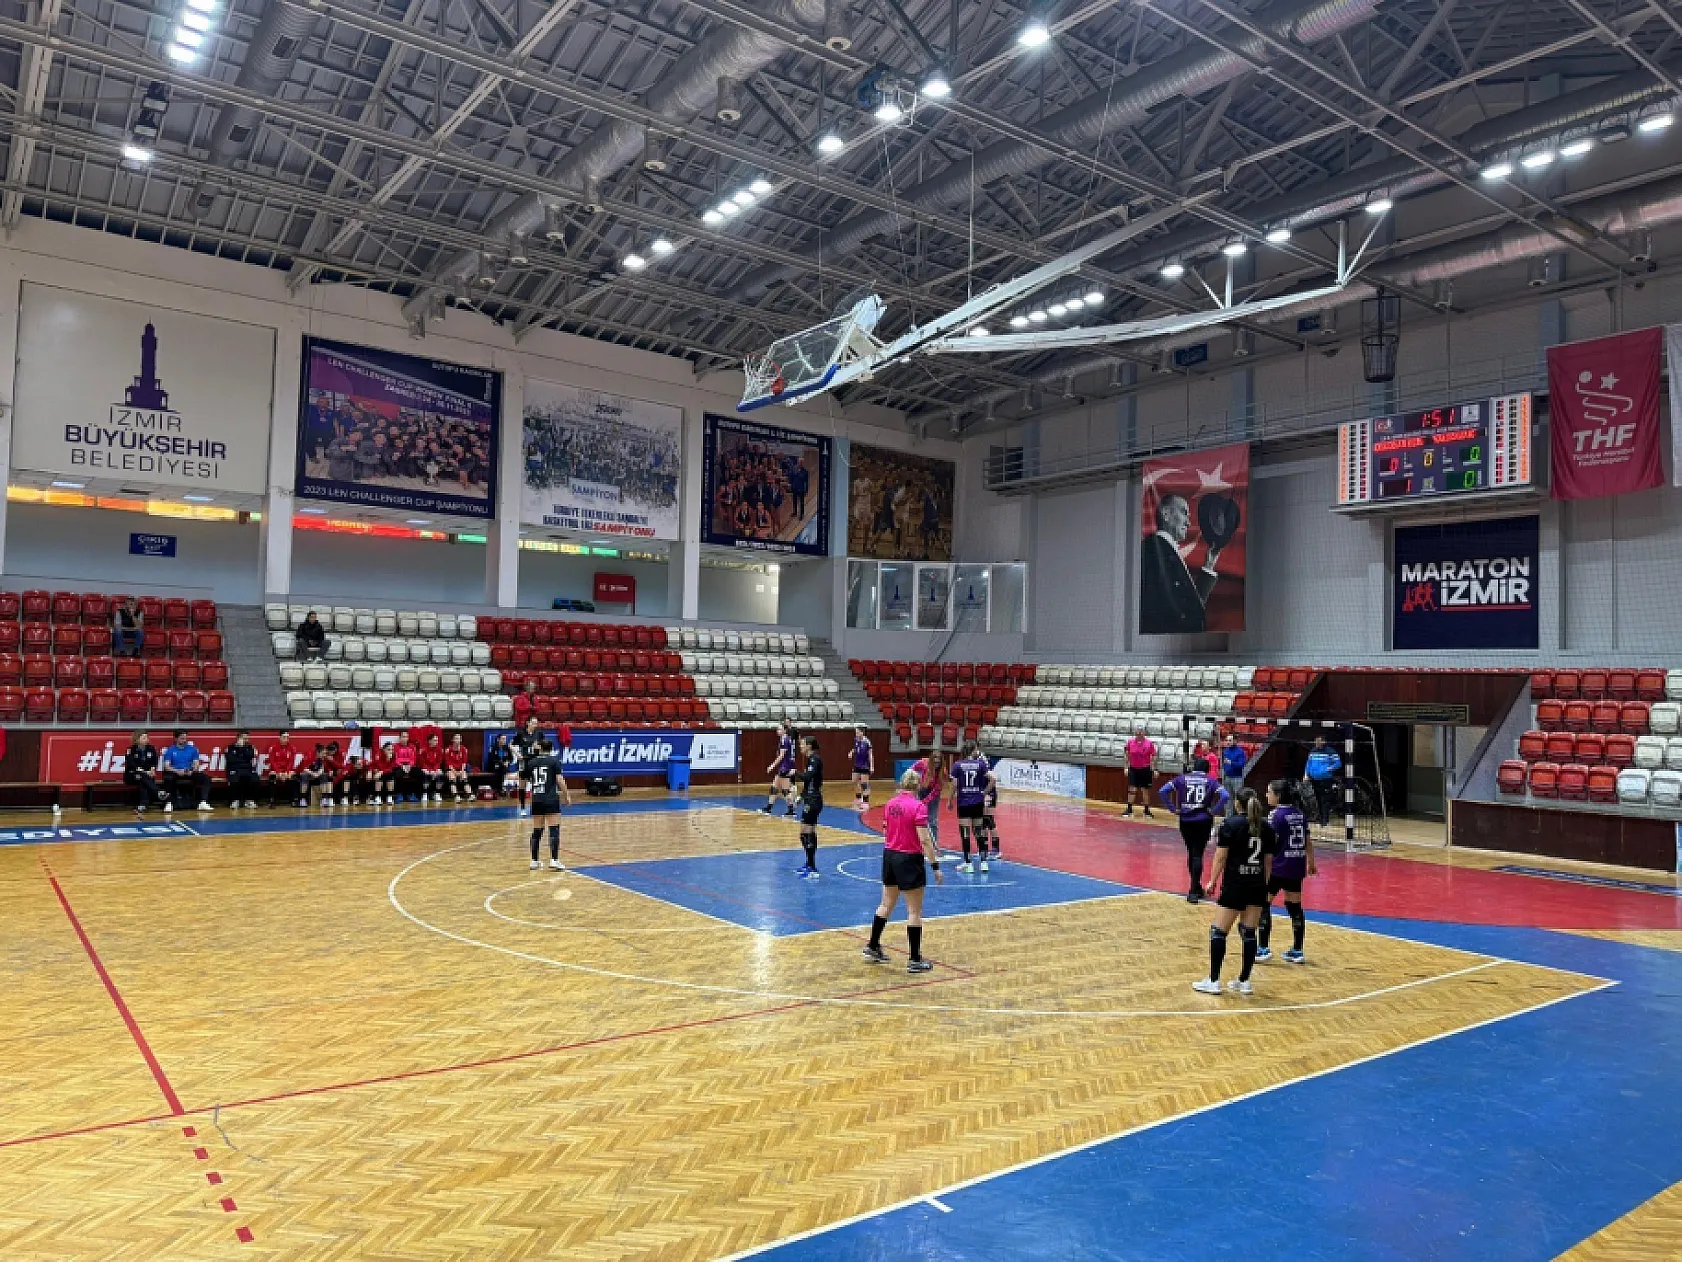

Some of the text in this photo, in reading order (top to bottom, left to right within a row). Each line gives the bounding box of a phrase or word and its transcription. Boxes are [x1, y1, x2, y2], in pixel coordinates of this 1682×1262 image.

[109, 406, 182, 432] İZMİR
[64, 422, 227, 460] BÜYÜKŞEHİR
[1572, 422, 1637, 452] THF
[71, 448, 219, 479] BELEDİYESİ
[350, 490, 413, 506] CHALLENGER
[1401, 556, 1530, 582] MARATON
[562, 743, 615, 764] kenti
[533, 766, 548, 786] 15
[963, 770, 977, 787] 17
[1186, 785, 1205, 803] 78
[1247, 836, 1262, 864] 2
